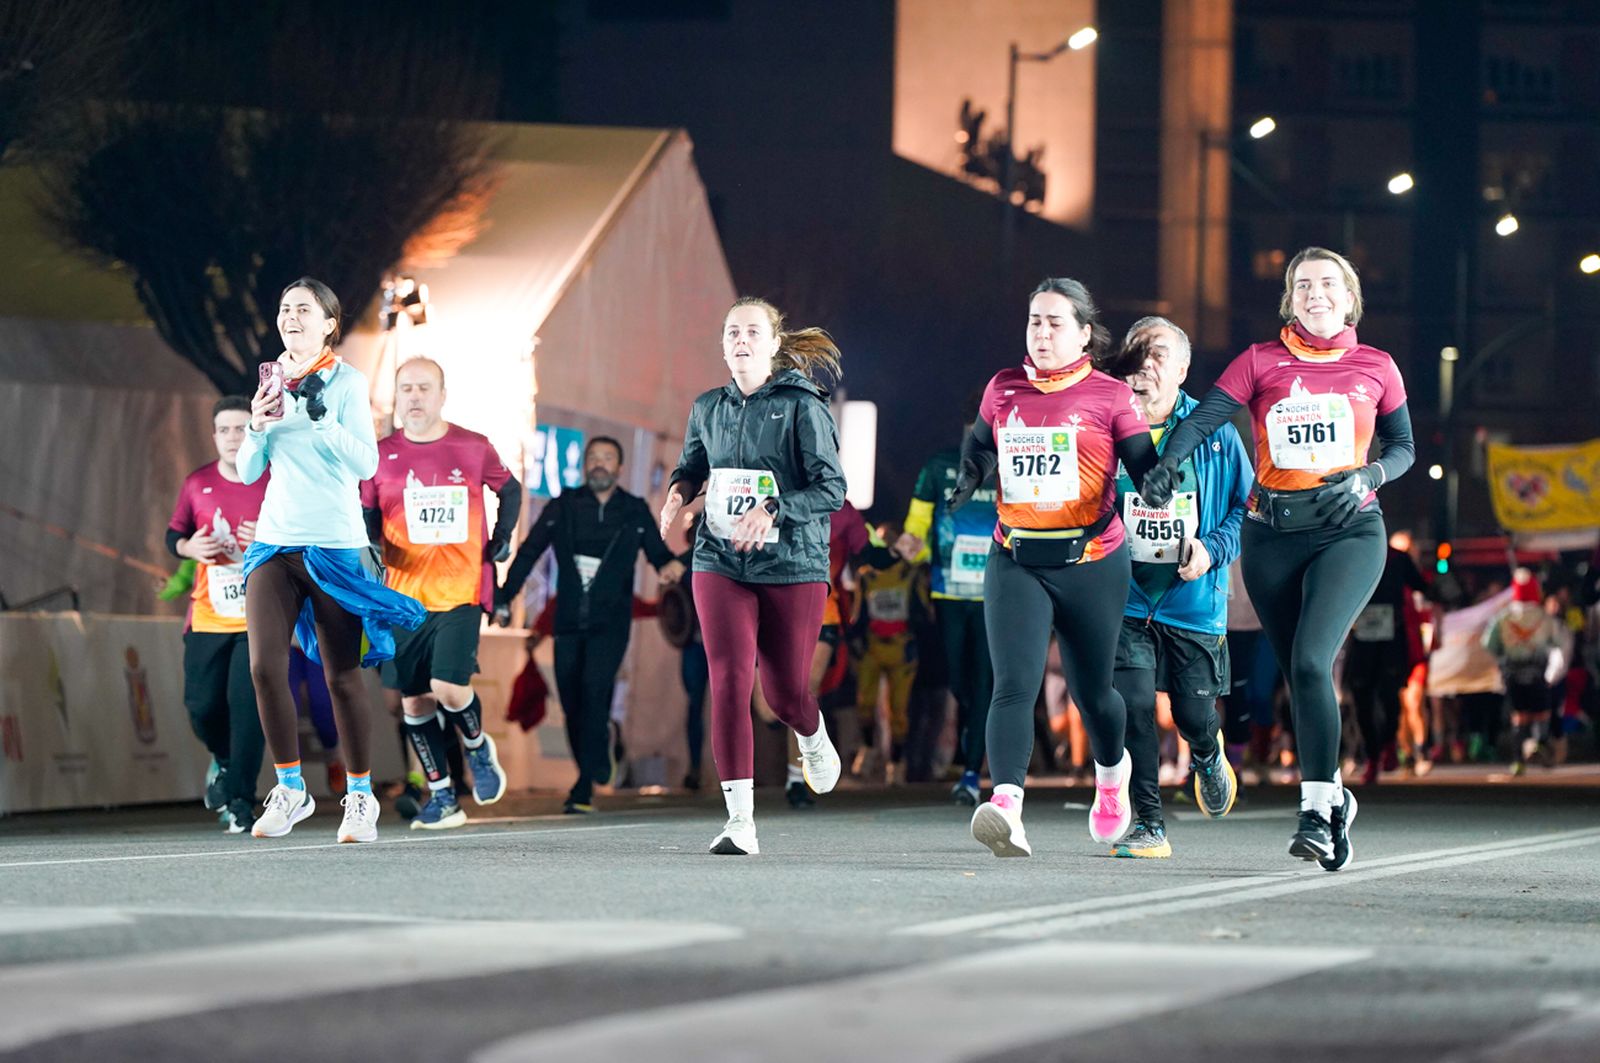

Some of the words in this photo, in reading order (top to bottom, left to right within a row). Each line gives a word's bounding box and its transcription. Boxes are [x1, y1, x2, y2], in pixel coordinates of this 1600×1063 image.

[1285, 404, 1309, 413] NOCHE
[1311, 403, 1320, 411] DE
[1276, 415, 1293, 424] SAN
[1287, 422, 1336, 445] 5761
[1012, 436, 1035, 444] NOCHE
[1036, 436, 1045, 444] DE
[1005, 445, 1020, 454] SAN
[1012, 454, 1061, 477] 5762
[419, 507, 455, 523] 4724
[1131, 508, 1147, 517] SAN
[1135, 518, 1185, 541] 4559
